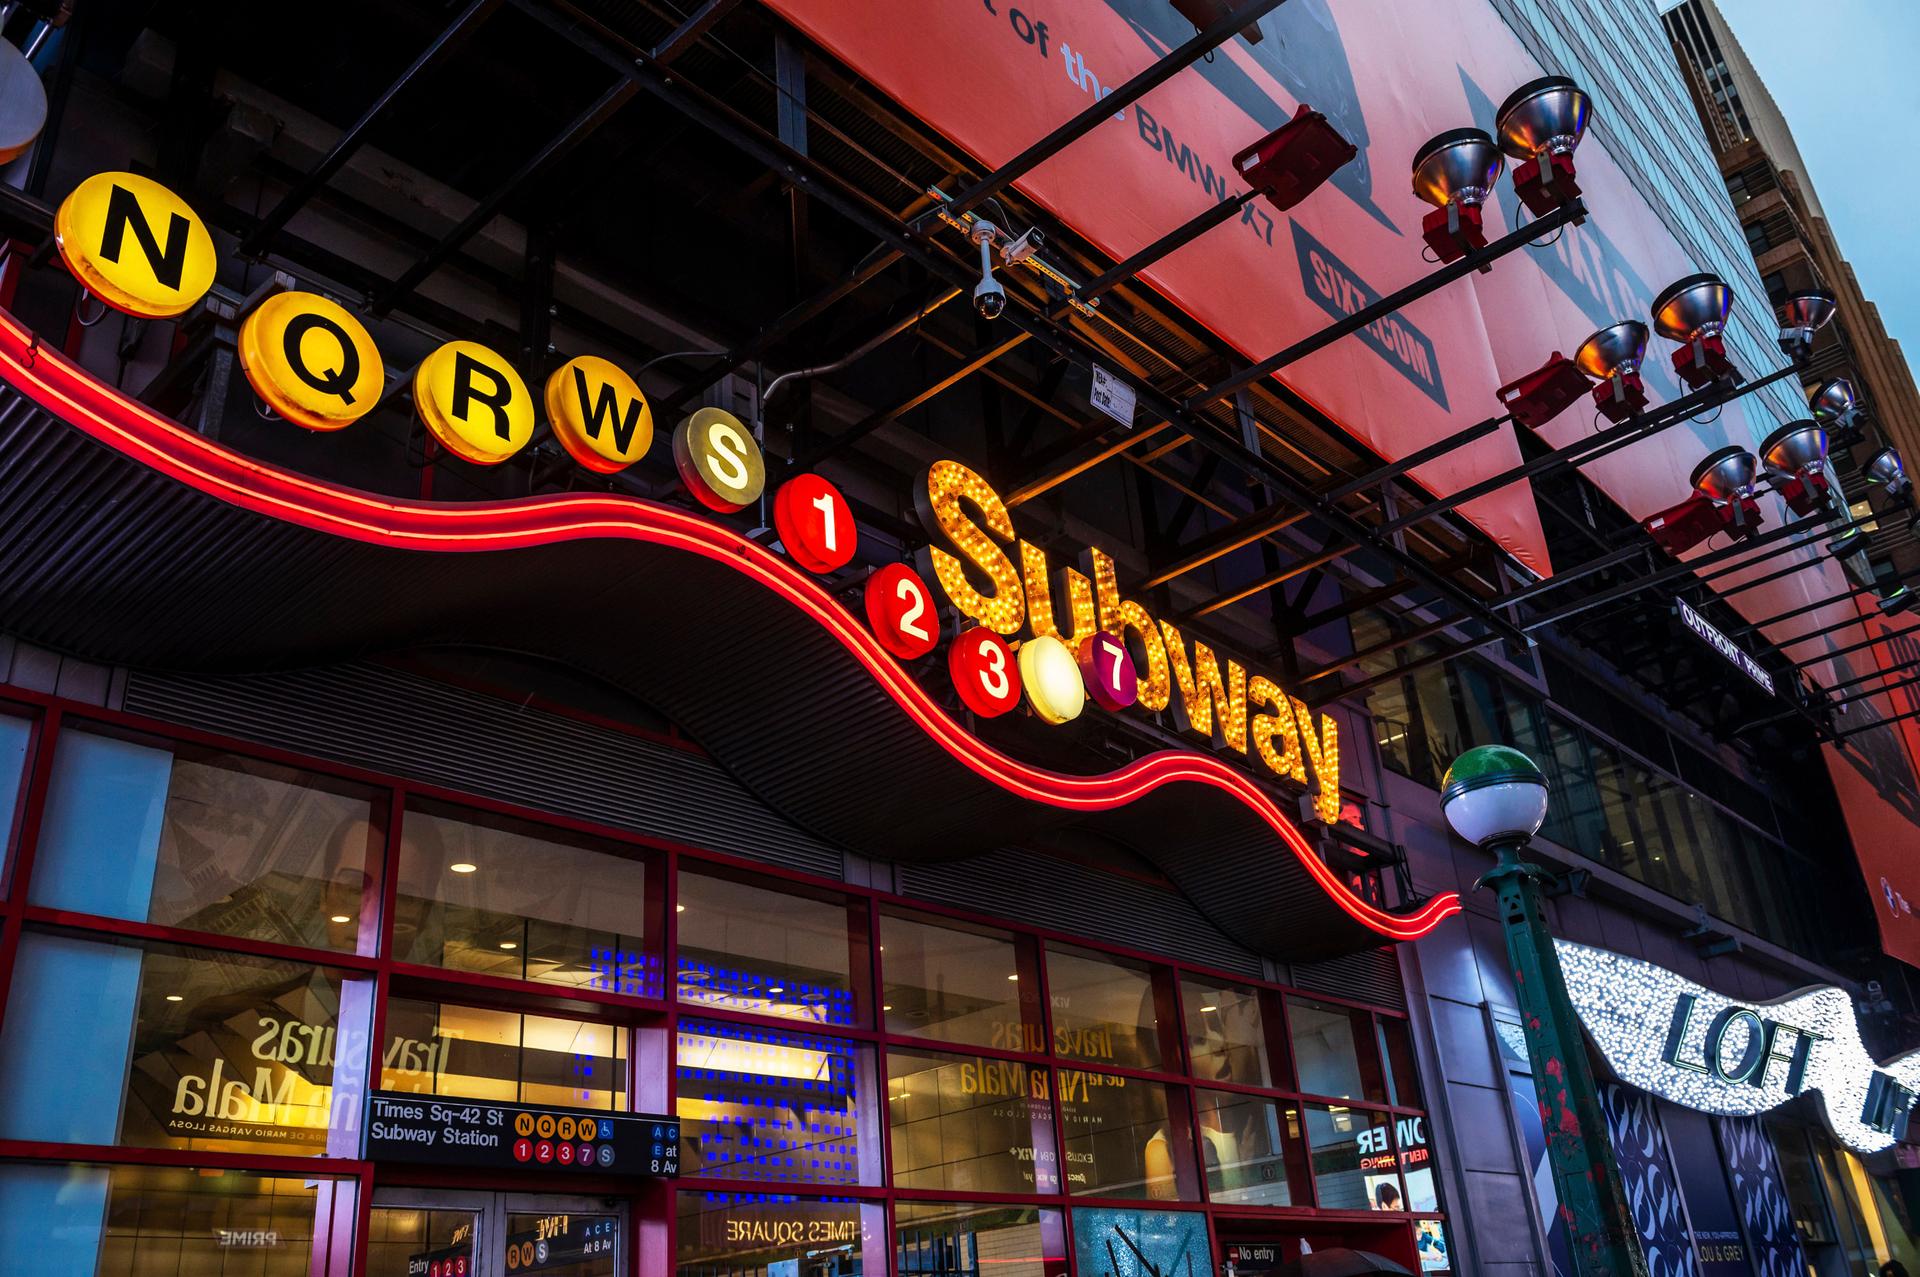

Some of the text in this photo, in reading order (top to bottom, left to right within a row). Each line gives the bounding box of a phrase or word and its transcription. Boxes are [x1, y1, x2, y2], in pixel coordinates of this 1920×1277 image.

[1010, 8, 1049, 58] of
[1135, 103, 1226, 202] BMW
[1235, 189, 1274, 247] X7
[99, 184, 1124, 699] N Q R W S 1 2 3 7
[927, 459, 1340, 825] Subway
[1682, 604, 1775, 693] OUTFRONT PRIME
[1661, 993, 1826, 1097] LOFT
[373, 1100, 504, 1126] Times Sq-42 St
[371, 1122, 499, 1147] Subway Station
[519, 1119, 594, 1137] N Q R W
[540, 1146, 549, 1159] 2
[561, 1147, 571, 1160] 3
[582, 1149, 590, 1162] 7
[601, 1149, 611, 1163] S
[665, 1146, 677, 1158] at
[650, 1161, 677, 1174] 8 Av
[521, 1248, 533, 1260] W
[538, 1244, 546, 1258] S
[584, 1243, 593, 1254] At
[602, 1239, 611, 1250] Av
[1238, 1246, 1274, 1263] No entry
[1715, 1245, 1723, 1262] &
[1723, 1245, 1745, 1262] GREY
[409, 1259, 430, 1274] Entry
